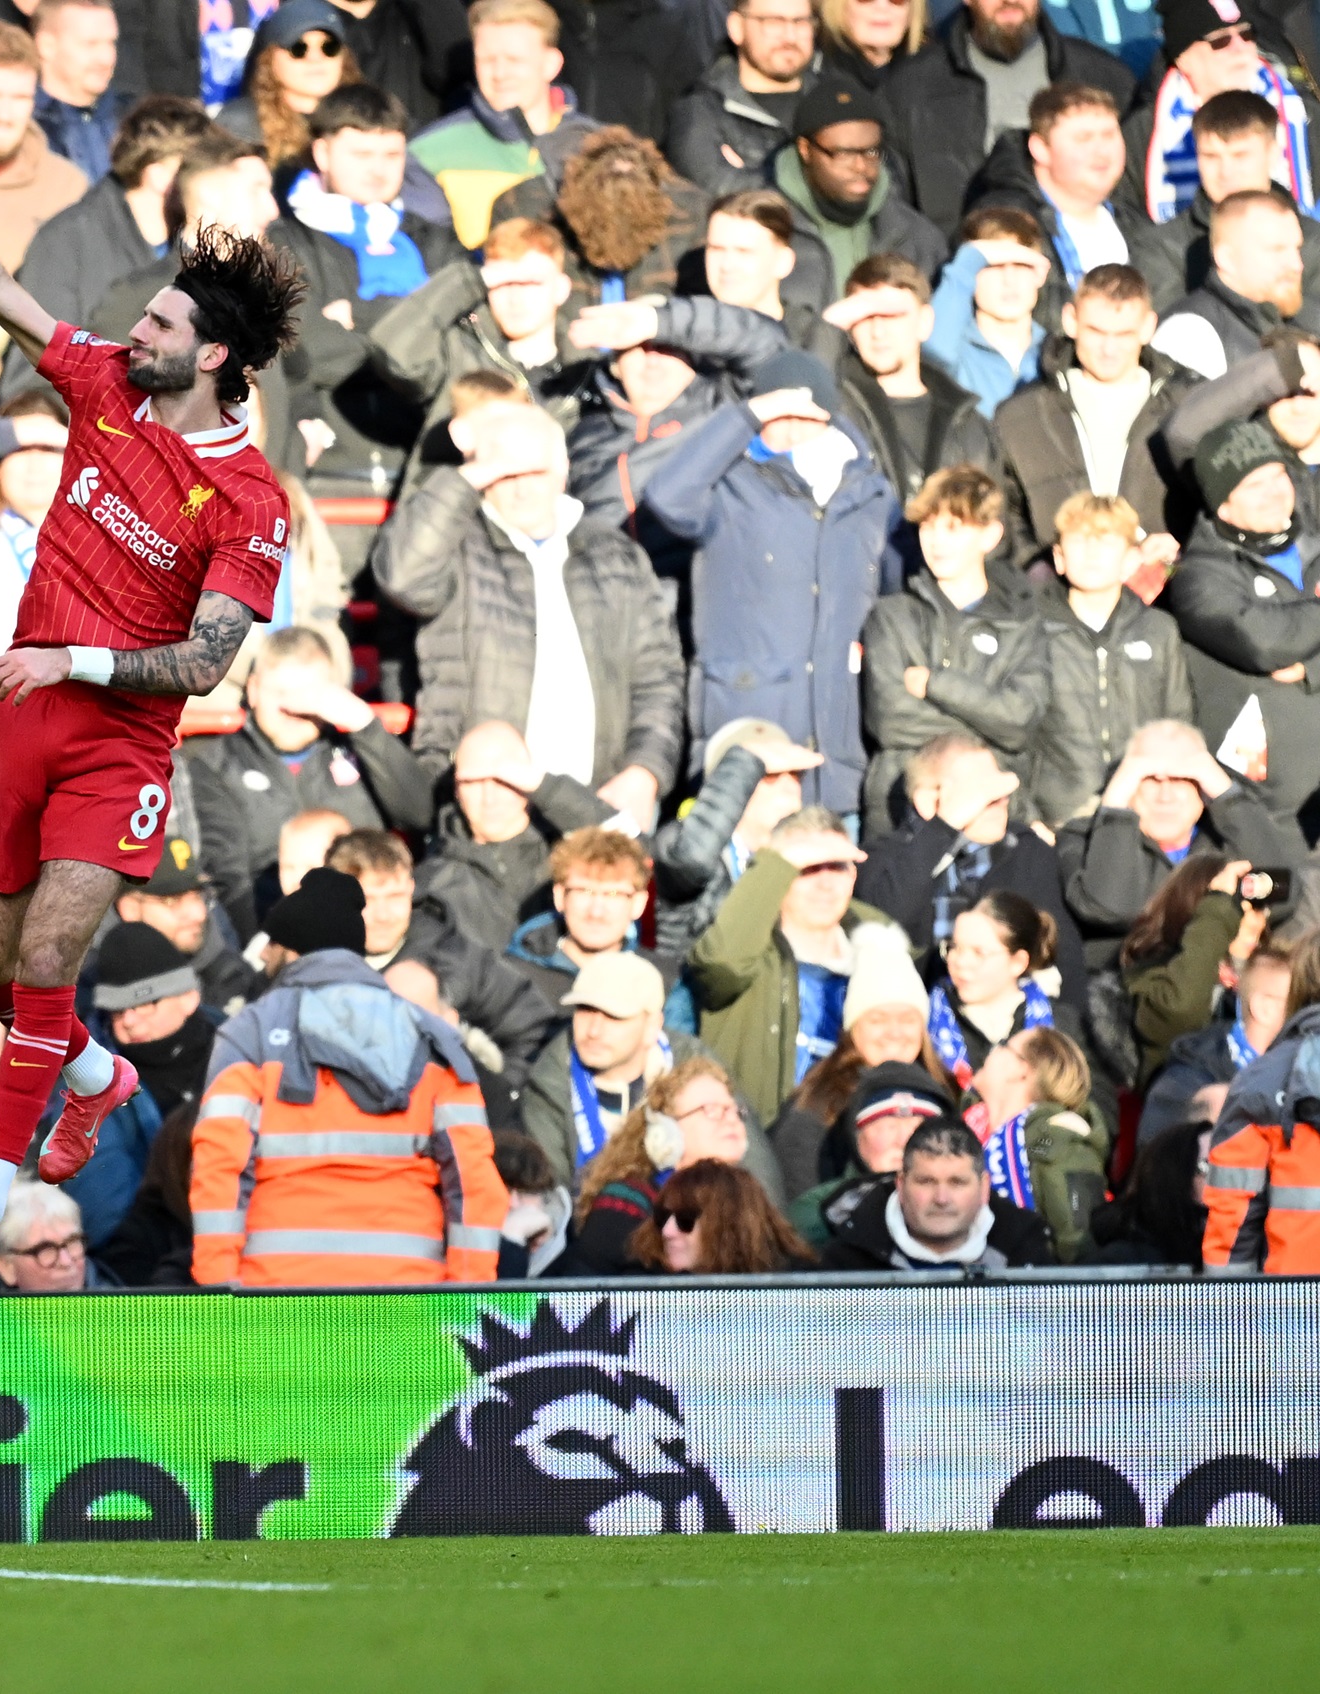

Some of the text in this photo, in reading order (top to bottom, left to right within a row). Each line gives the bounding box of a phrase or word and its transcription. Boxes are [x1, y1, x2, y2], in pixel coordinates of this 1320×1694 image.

[91, 506, 177, 571] chartered
[100, 492, 179, 558] standard
[130, 783, 166, 840] 8
[169, 839, 191, 871] P
